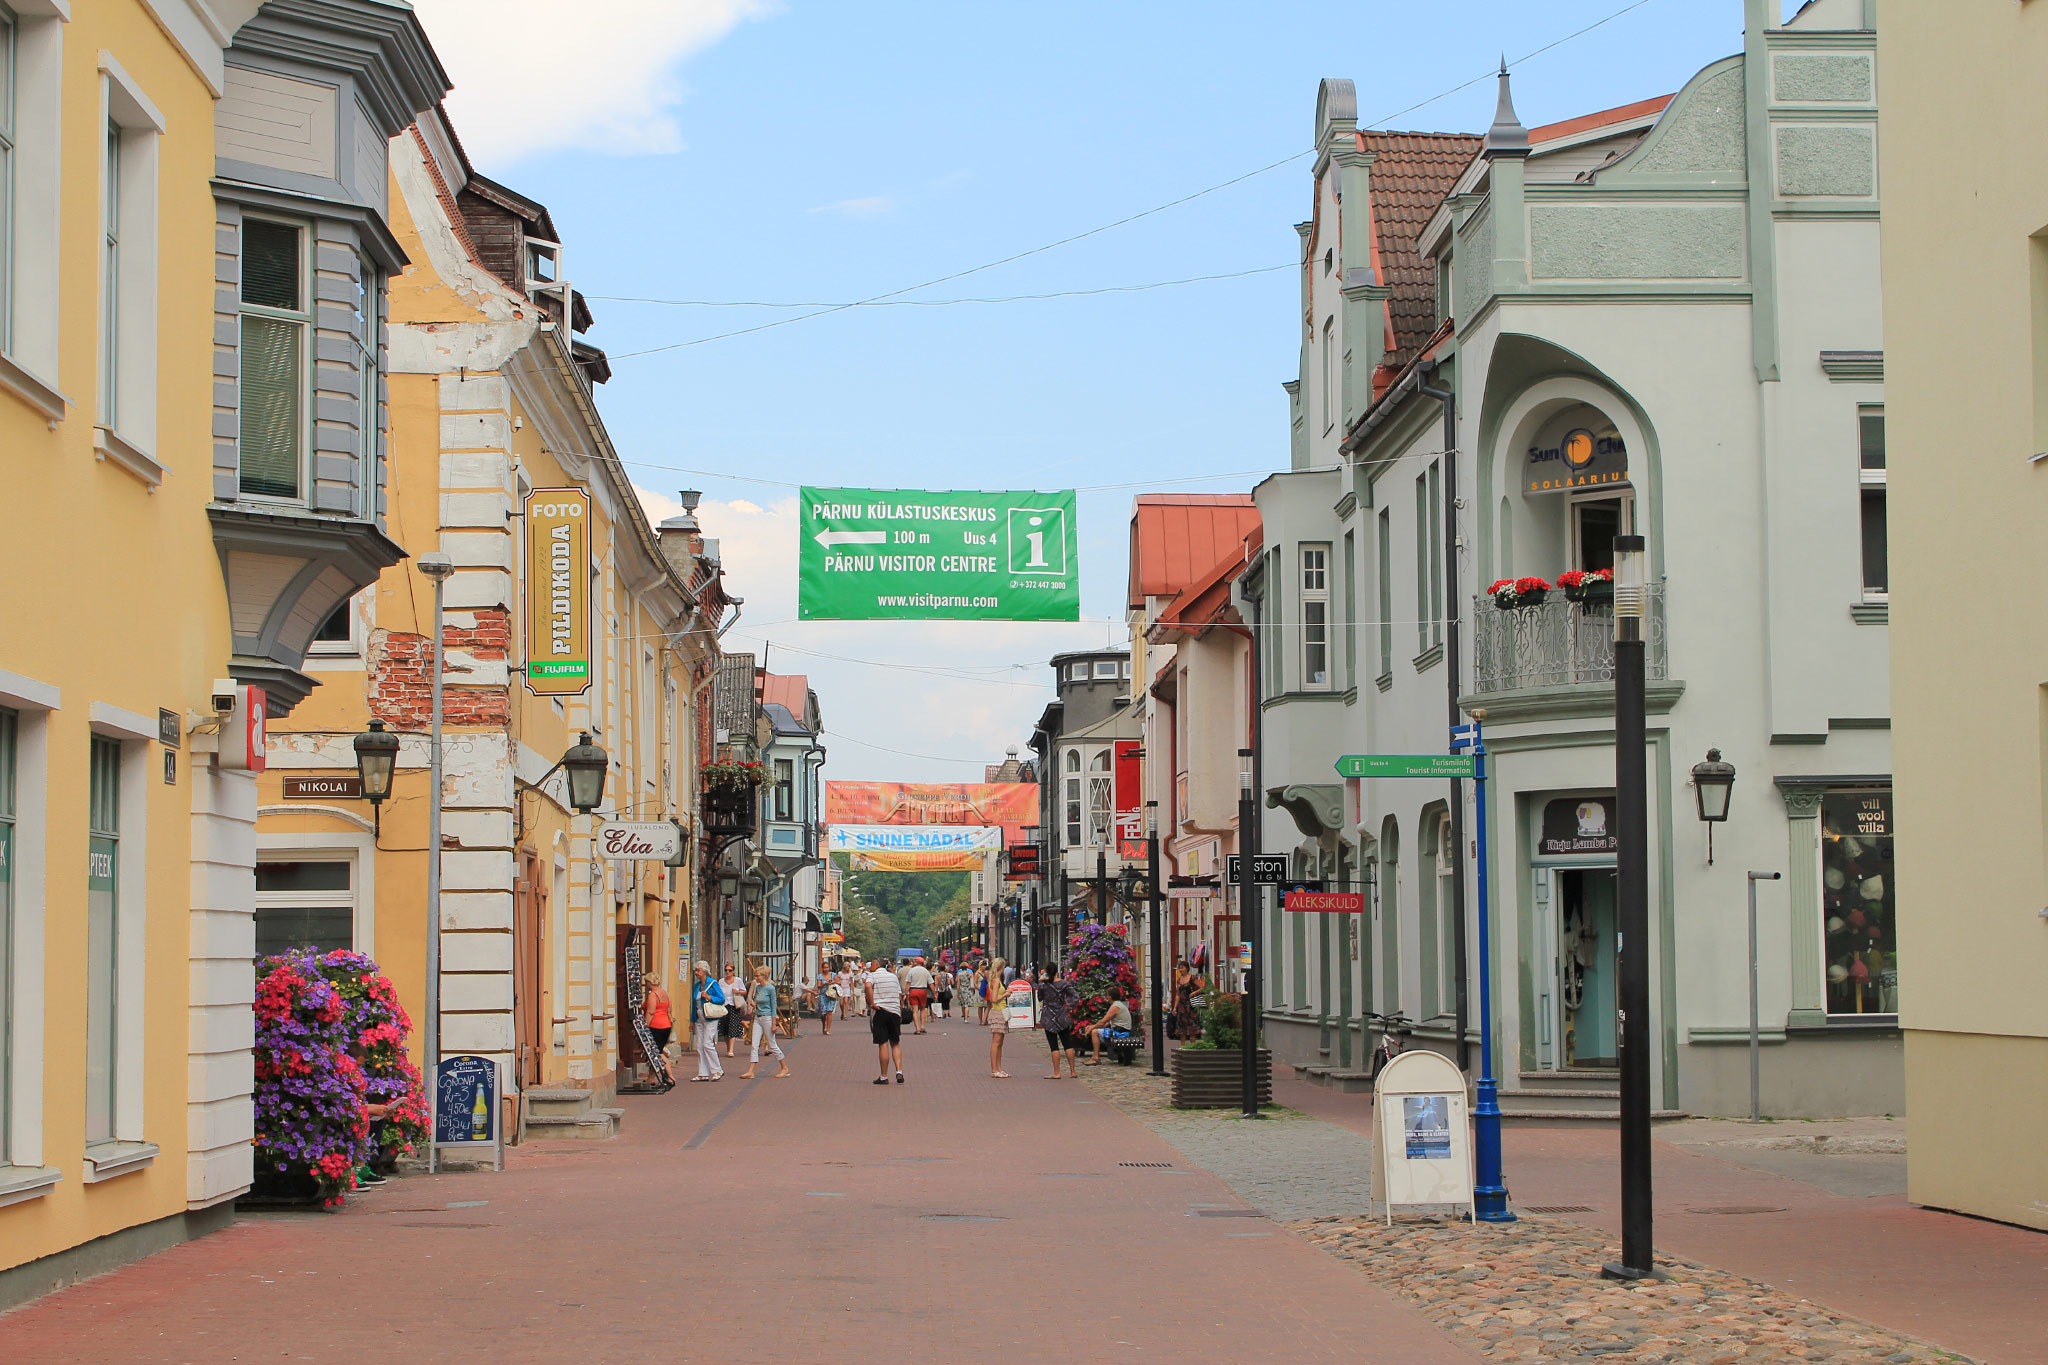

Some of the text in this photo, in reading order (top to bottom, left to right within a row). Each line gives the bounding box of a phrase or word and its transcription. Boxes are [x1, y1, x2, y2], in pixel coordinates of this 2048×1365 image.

[1527, 446, 1560, 463] Sun
[532, 503, 582, 518] FOTO
[812, 500, 997, 522] PÄRNU KÜLASTUSKESKUS
[893, 531, 930, 544] 100 m
[963, 531, 997, 545] Uus 4
[824, 552, 997, 573] PÄRNU VISITOR CENTRE
[551, 523, 571, 655] PILDIKODA
[1038, 581, 1050, 589] 447
[1051, 581, 1066, 590] 3000
[877, 593, 998, 609] www.visitparnu.com
[544, 664, 584, 674] FUJIFILM
[166, 754, 174, 779] 14
[1431, 758, 1471, 767] Turismiinfo
[299, 782, 348, 792] NIKOLAI
[1861, 798, 1880, 809] vill
[1856, 810, 1886, 821] wool
[1857, 821, 1885, 833] villa
[604, 829, 654, 856] Elia
[856, 830, 974, 847] SININE NÄDAL
[1122, 841, 1147, 860] Pub
[89, 852, 112, 878] PTEEK
[1233, 859, 1282, 872] Rston
